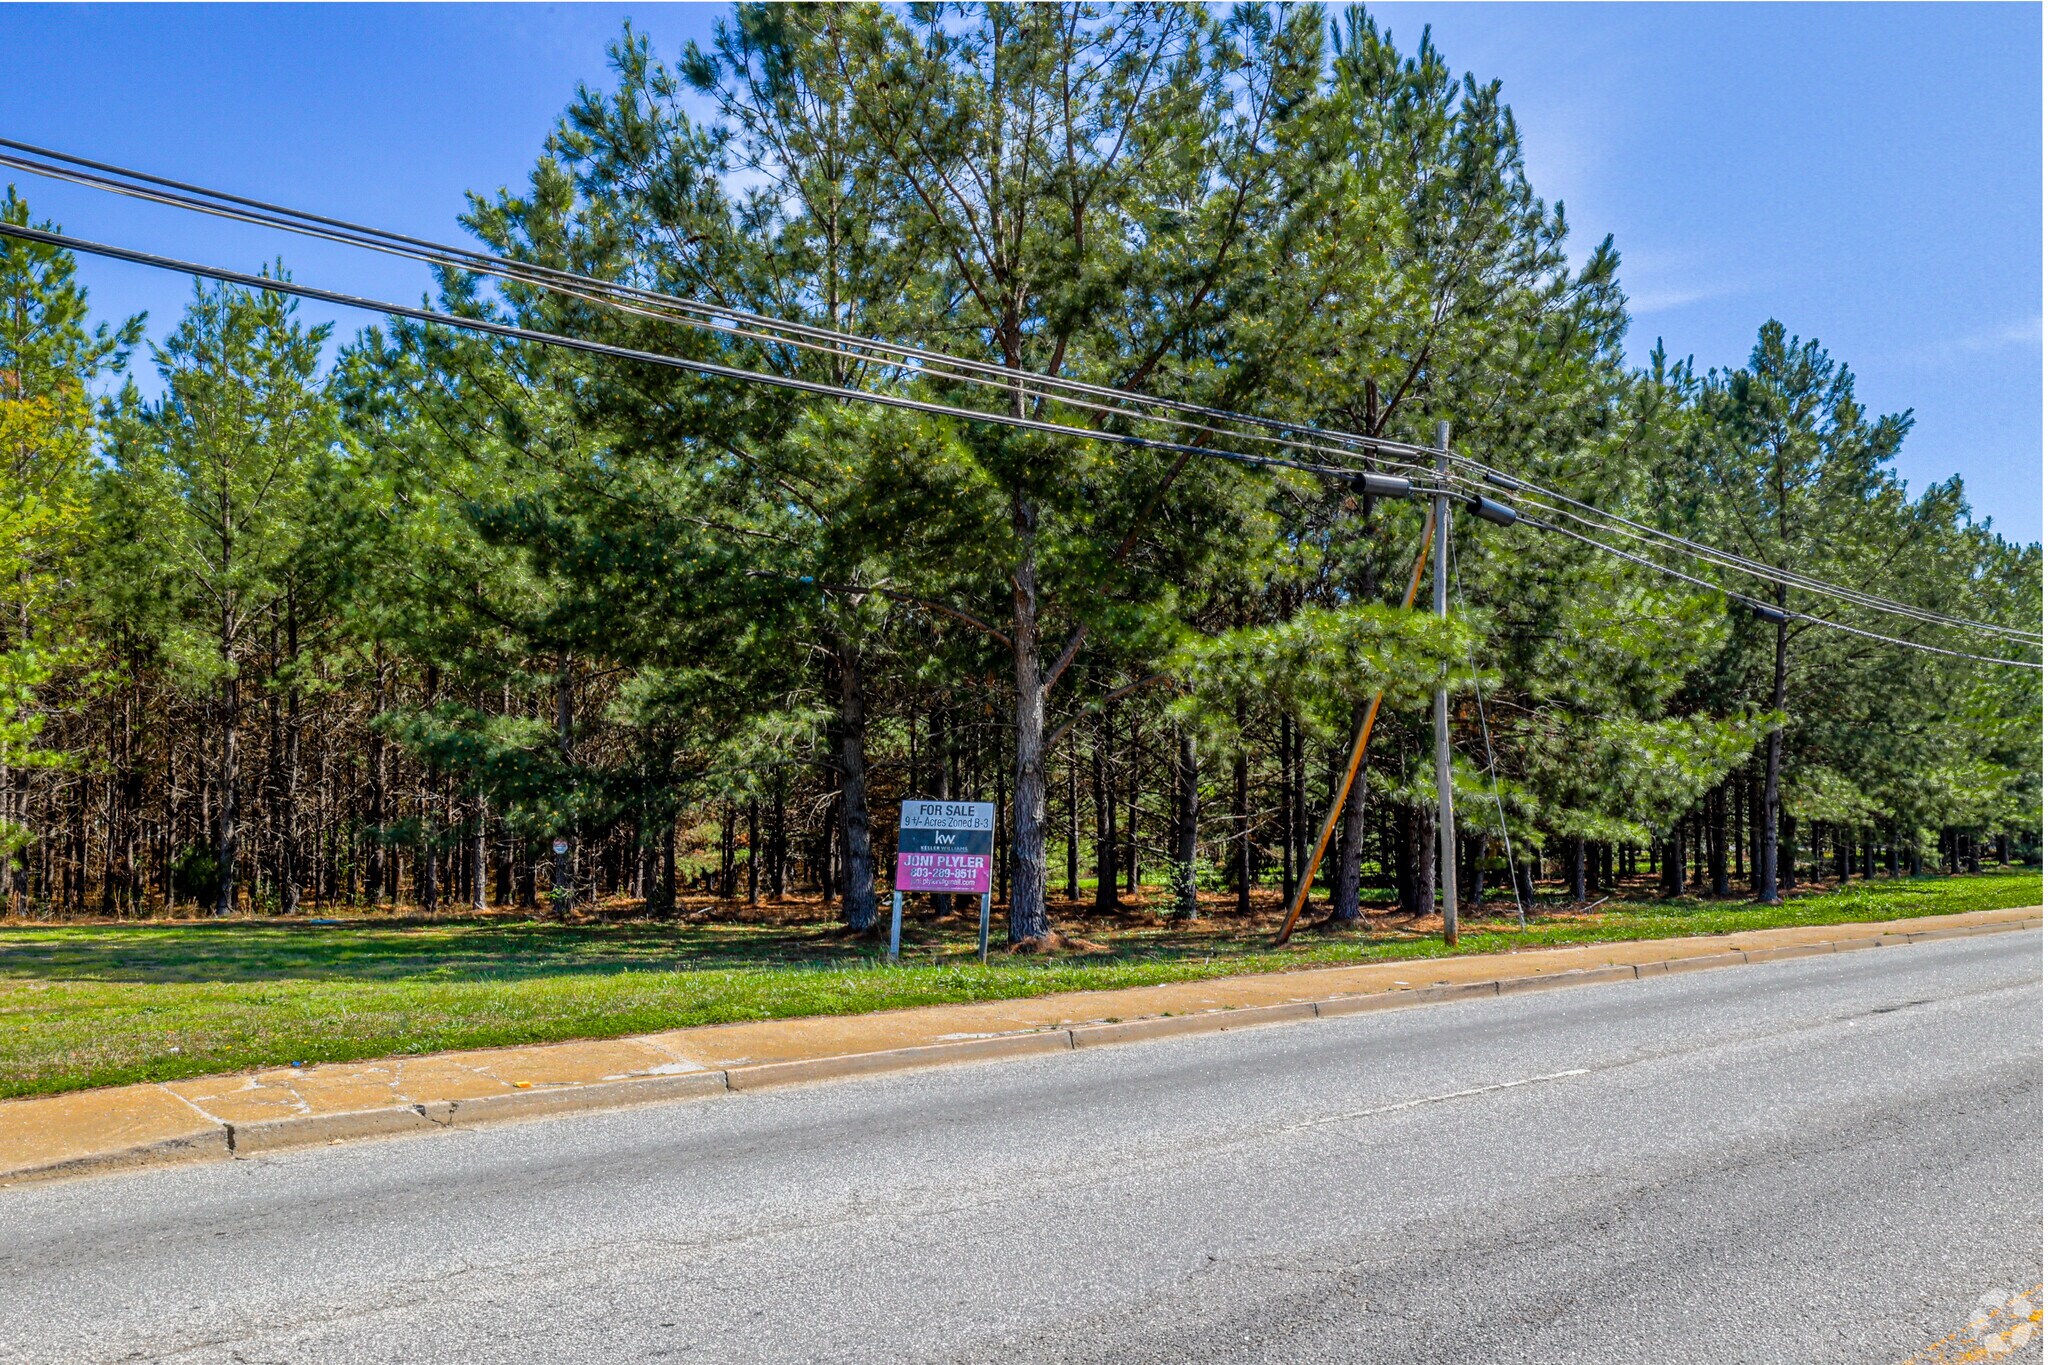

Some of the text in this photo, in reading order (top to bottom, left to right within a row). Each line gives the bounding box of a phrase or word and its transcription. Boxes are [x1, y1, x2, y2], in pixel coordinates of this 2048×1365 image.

[920, 804, 975, 816] FOR SALE
[924, 817, 947, 827] Acres
[948, 817, 972, 828] Zoned
[974, 818, 989, 828] B-3
[903, 855, 984, 868] JONI PLYLER
[910, 867, 977, 878] 803-289-8511
